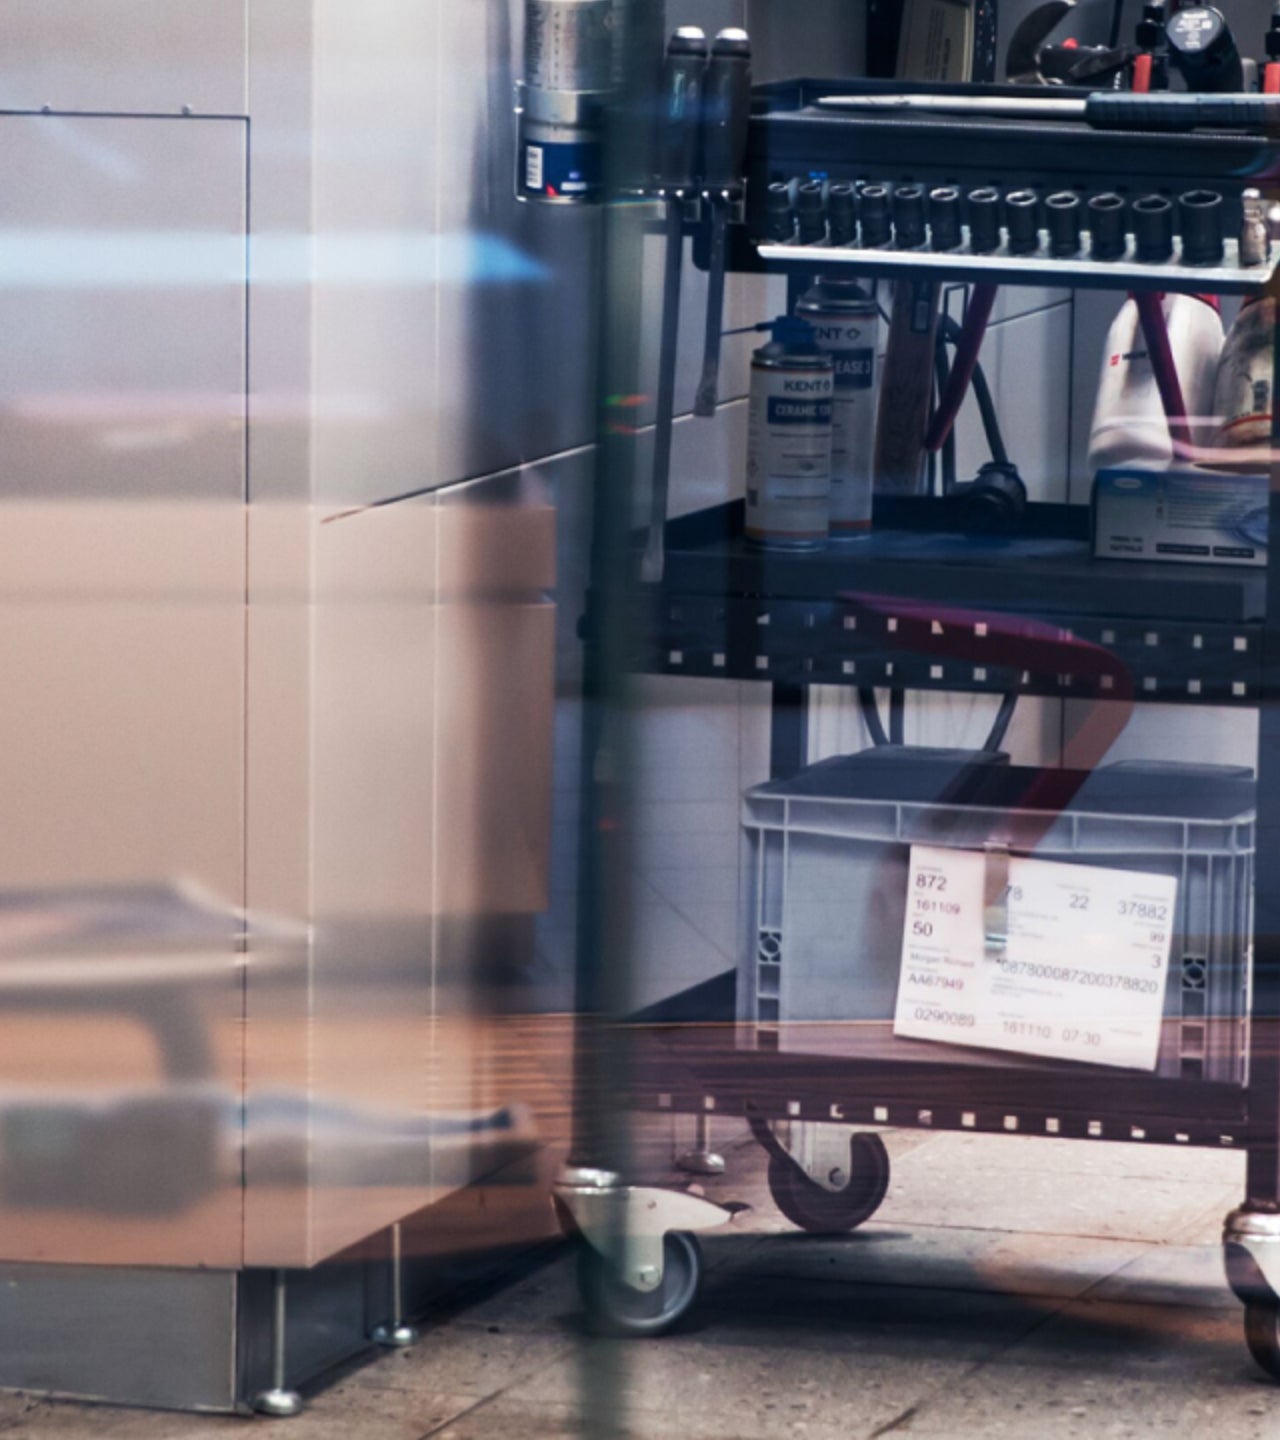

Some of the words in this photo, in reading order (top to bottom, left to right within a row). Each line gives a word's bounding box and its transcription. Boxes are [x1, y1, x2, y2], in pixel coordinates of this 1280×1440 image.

[784, 379, 822, 392] KENT
[916, 873, 947, 892] 872
[916, 899, 961, 915] 161109
[1068, 893, 1089, 910] 22
[1117, 900, 1167, 921] 37882
[912, 921, 933, 937] 50
